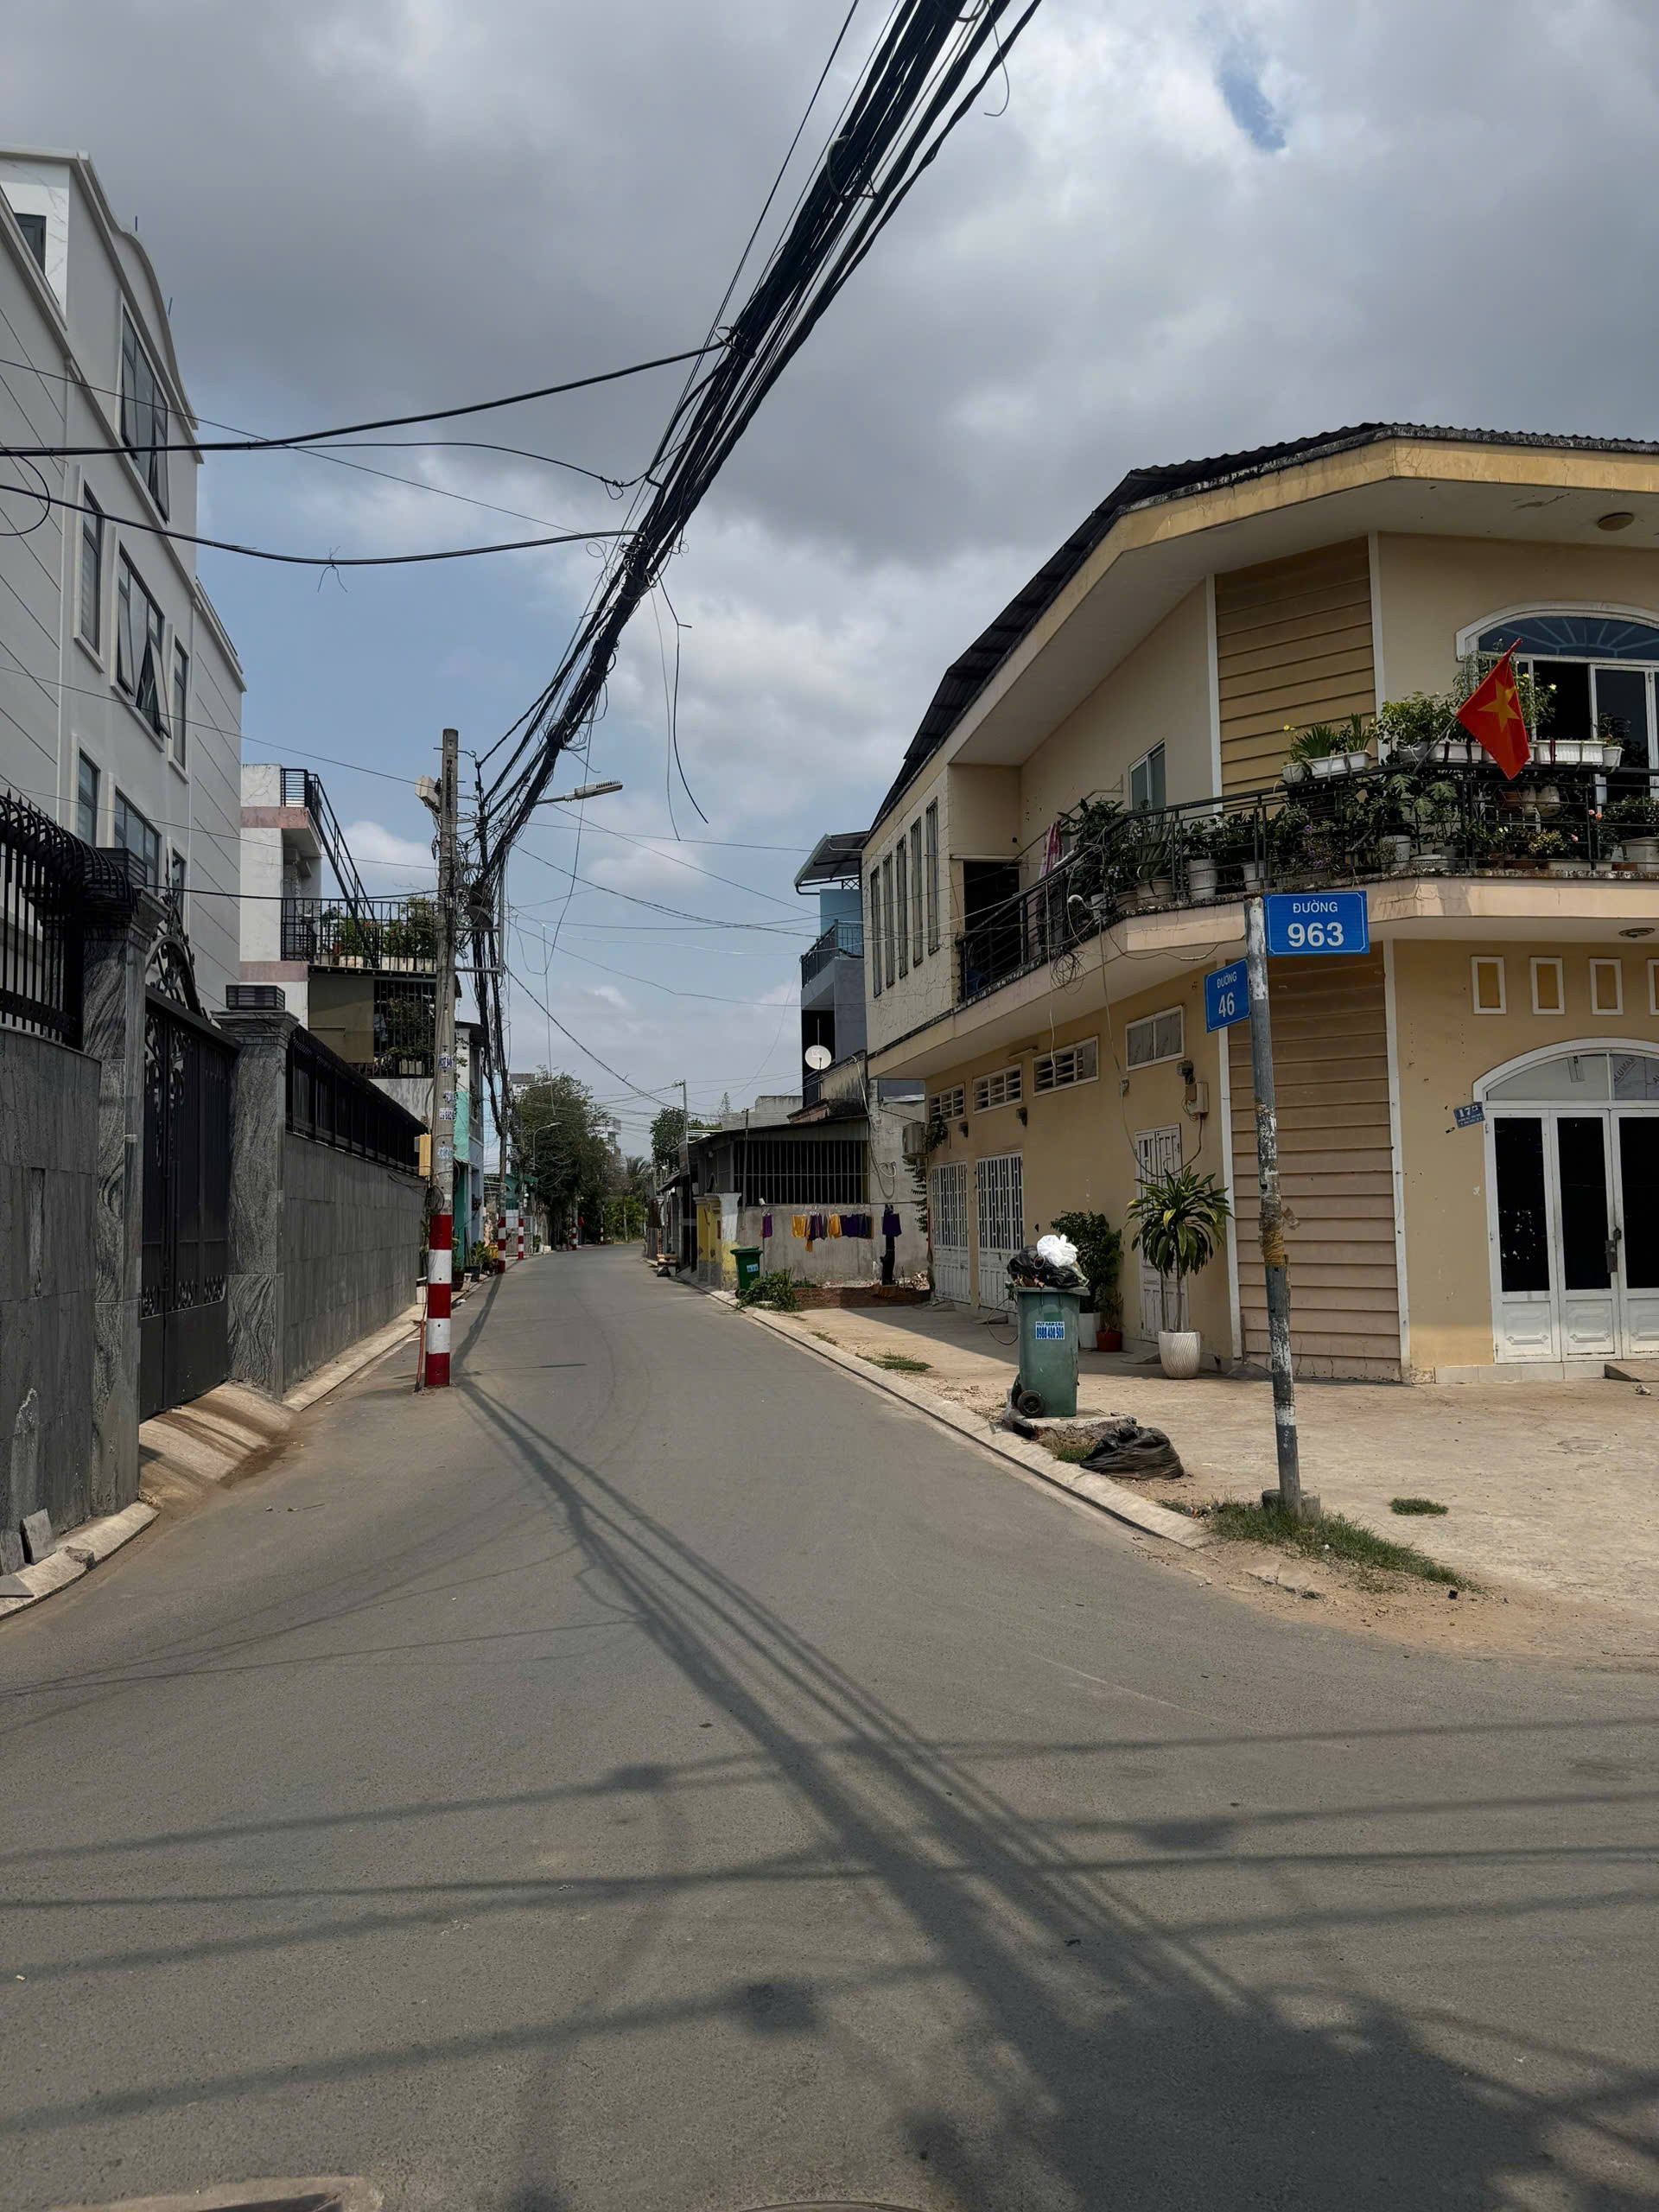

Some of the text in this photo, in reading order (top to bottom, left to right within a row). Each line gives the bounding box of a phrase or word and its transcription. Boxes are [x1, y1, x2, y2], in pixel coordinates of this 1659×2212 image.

[1293, 899, 1338, 913] ĐƯỜNG
[1287, 922, 1344, 947] 963
[1217, 970, 1237, 988] ĐƯỜNG
[1218, 991, 1235, 1018] 46
